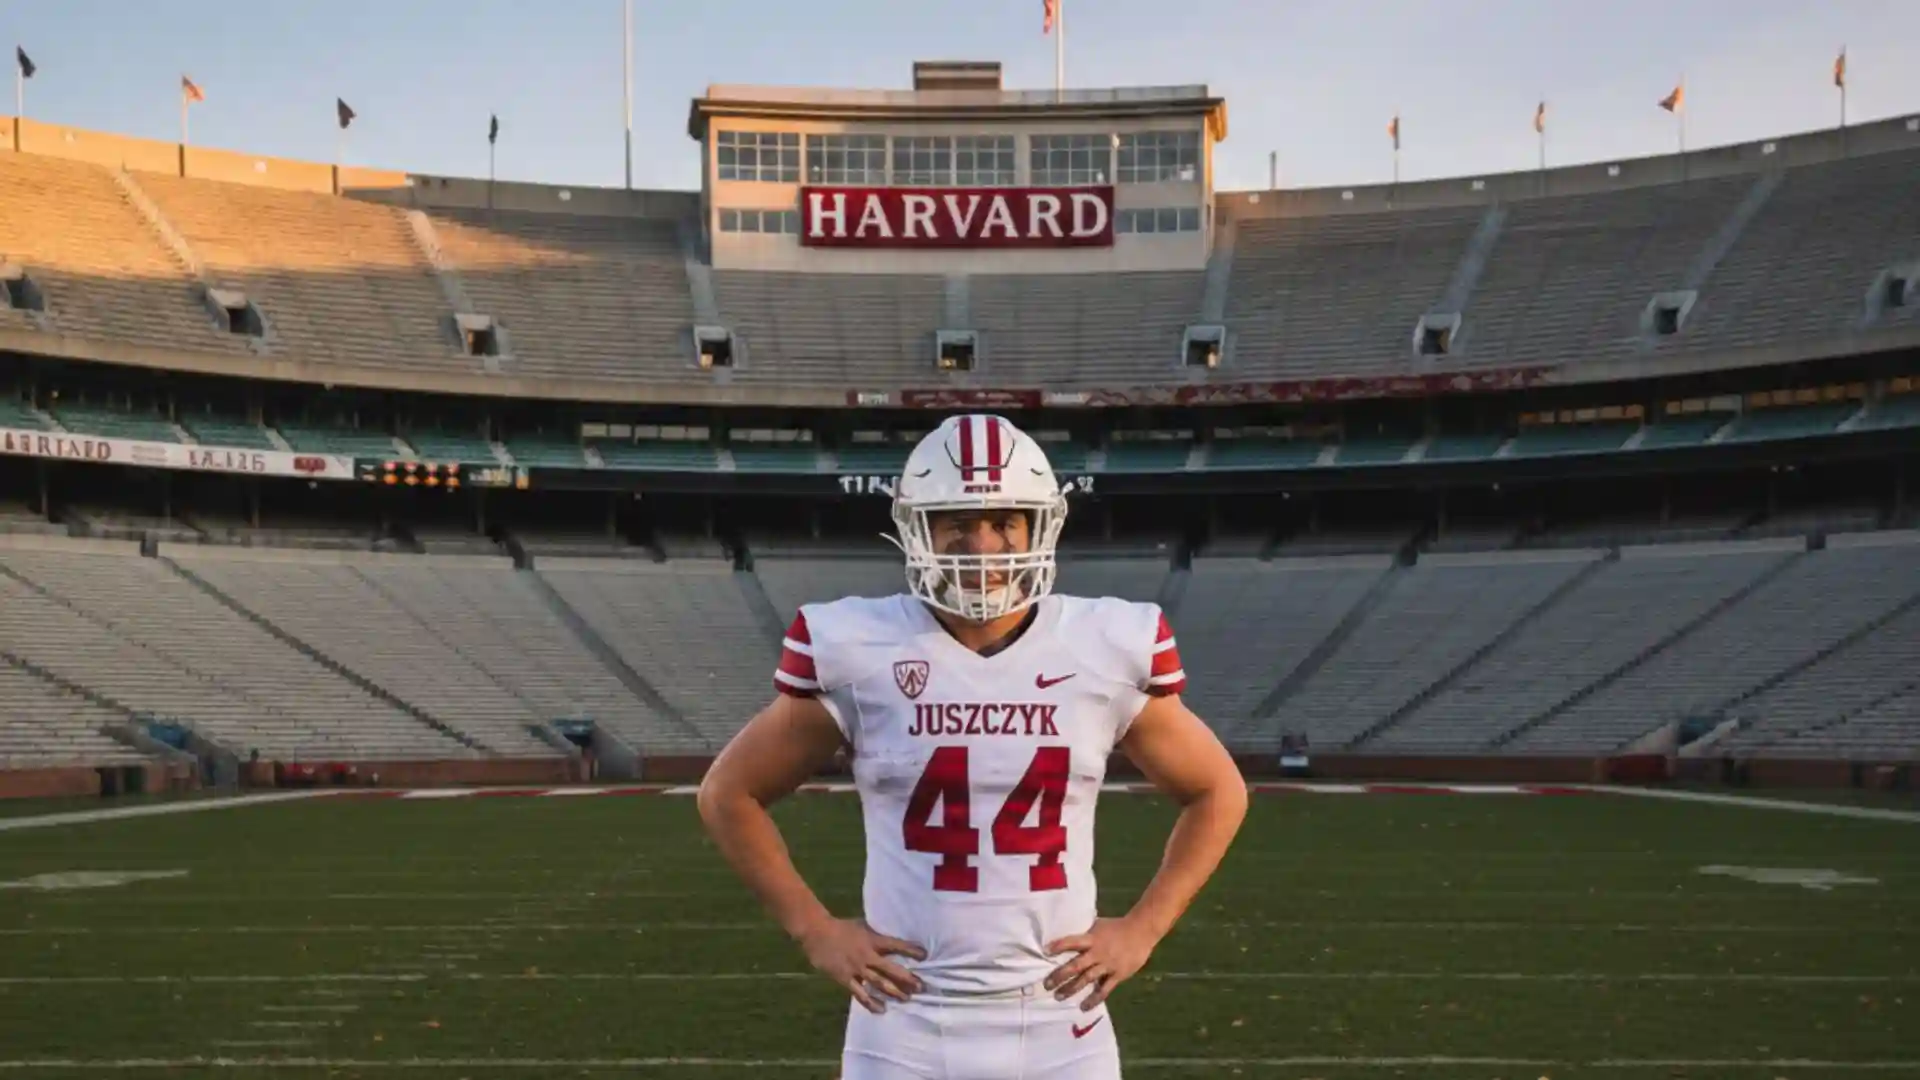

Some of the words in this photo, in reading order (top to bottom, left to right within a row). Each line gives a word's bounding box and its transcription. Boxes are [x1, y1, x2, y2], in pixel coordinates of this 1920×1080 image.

[808, 193, 1109, 238] HARVARD
[909, 703, 1060, 736] JUSZCZYK
[903, 746, 1071, 893] 44
